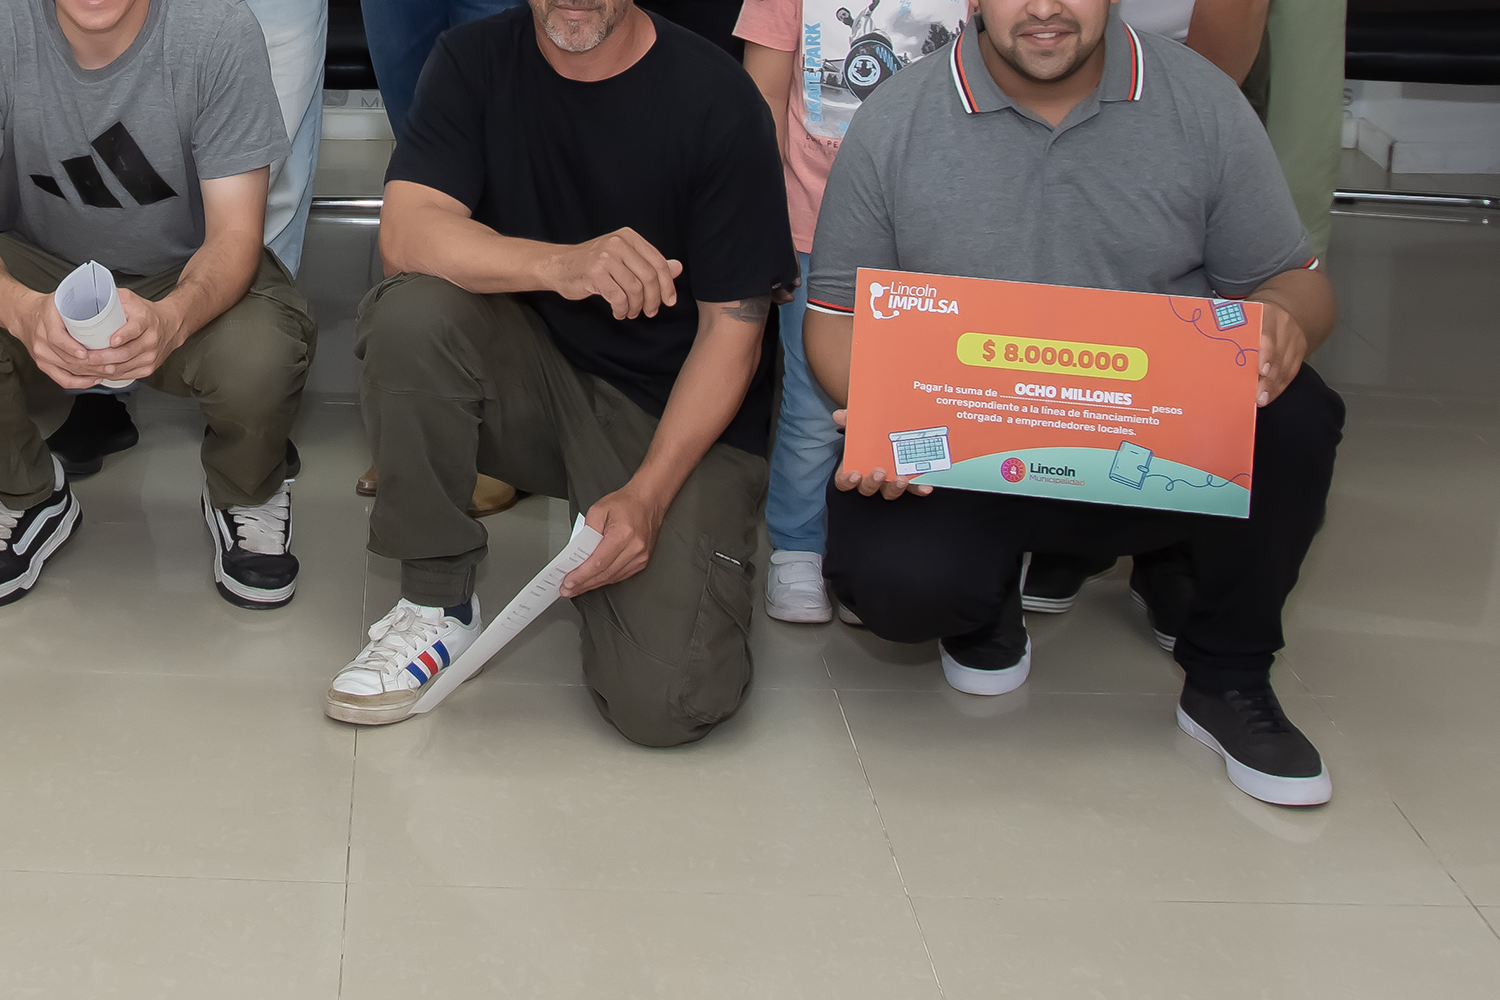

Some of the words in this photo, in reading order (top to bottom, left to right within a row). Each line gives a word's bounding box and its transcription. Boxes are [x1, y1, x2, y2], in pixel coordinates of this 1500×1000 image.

[804, 22, 821, 68] PARK
[804, 70, 822, 122] SKATE
[890, 281, 937, 299] Lincoln
[888, 296, 959, 316] IMPULSA
[982, 339, 996, 363] $
[1003, 345, 1130, 373] 8.000.000
[913, 381, 943, 393] Pagar
[944, 384, 953, 393] la
[955, 387, 983, 396] suma
[985, 389, 998, 397] de
[1151, 406, 1183, 415] pesos
[1015, 383, 1056, 398] OCHO
[1061, 387, 1132, 406] MILLONES
[936, 397, 1020, 412] correspondiente
[1030, 405, 1039, 414] la
[1041, 406, 1066, 417] línea
[1068, 409, 1081, 418] de
[1082, 410, 1160, 426] financiamiento
[956, 411, 1002, 423] otorgada
[1015, 417, 1096, 432] emprendedores
[1097, 424, 1137, 436] locales.
[1029, 473, 1085, 486] Municipalidad
[1030, 462, 1076, 477] Lincoln
